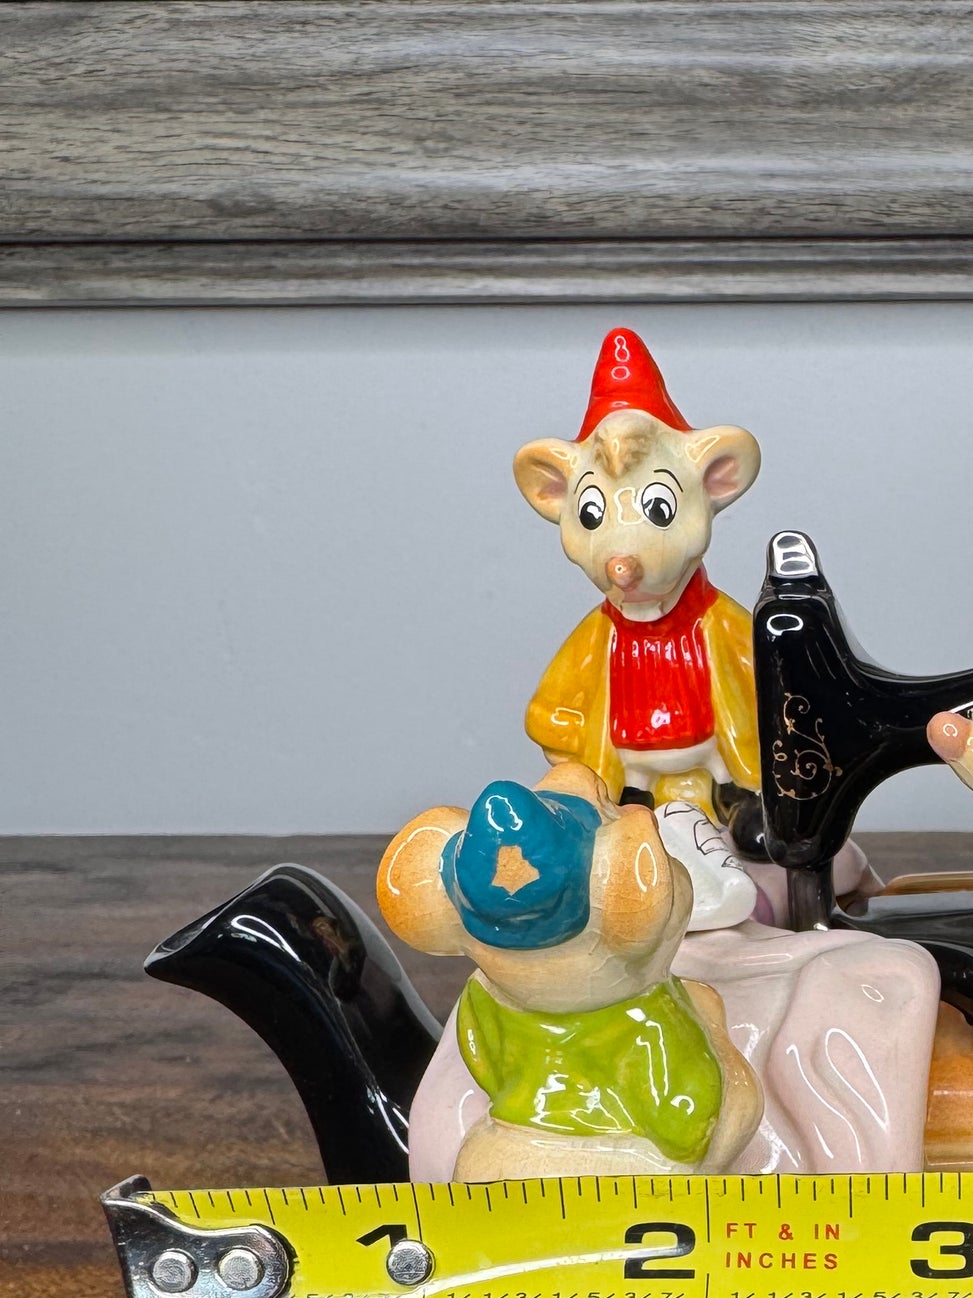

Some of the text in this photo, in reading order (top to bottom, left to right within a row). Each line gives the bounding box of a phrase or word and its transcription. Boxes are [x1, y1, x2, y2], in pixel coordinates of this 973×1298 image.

[726, 1222, 840, 1240] FT & IN
[623, 1221, 696, 1279] 2
[725, 1251, 838, 1270] INCHES
